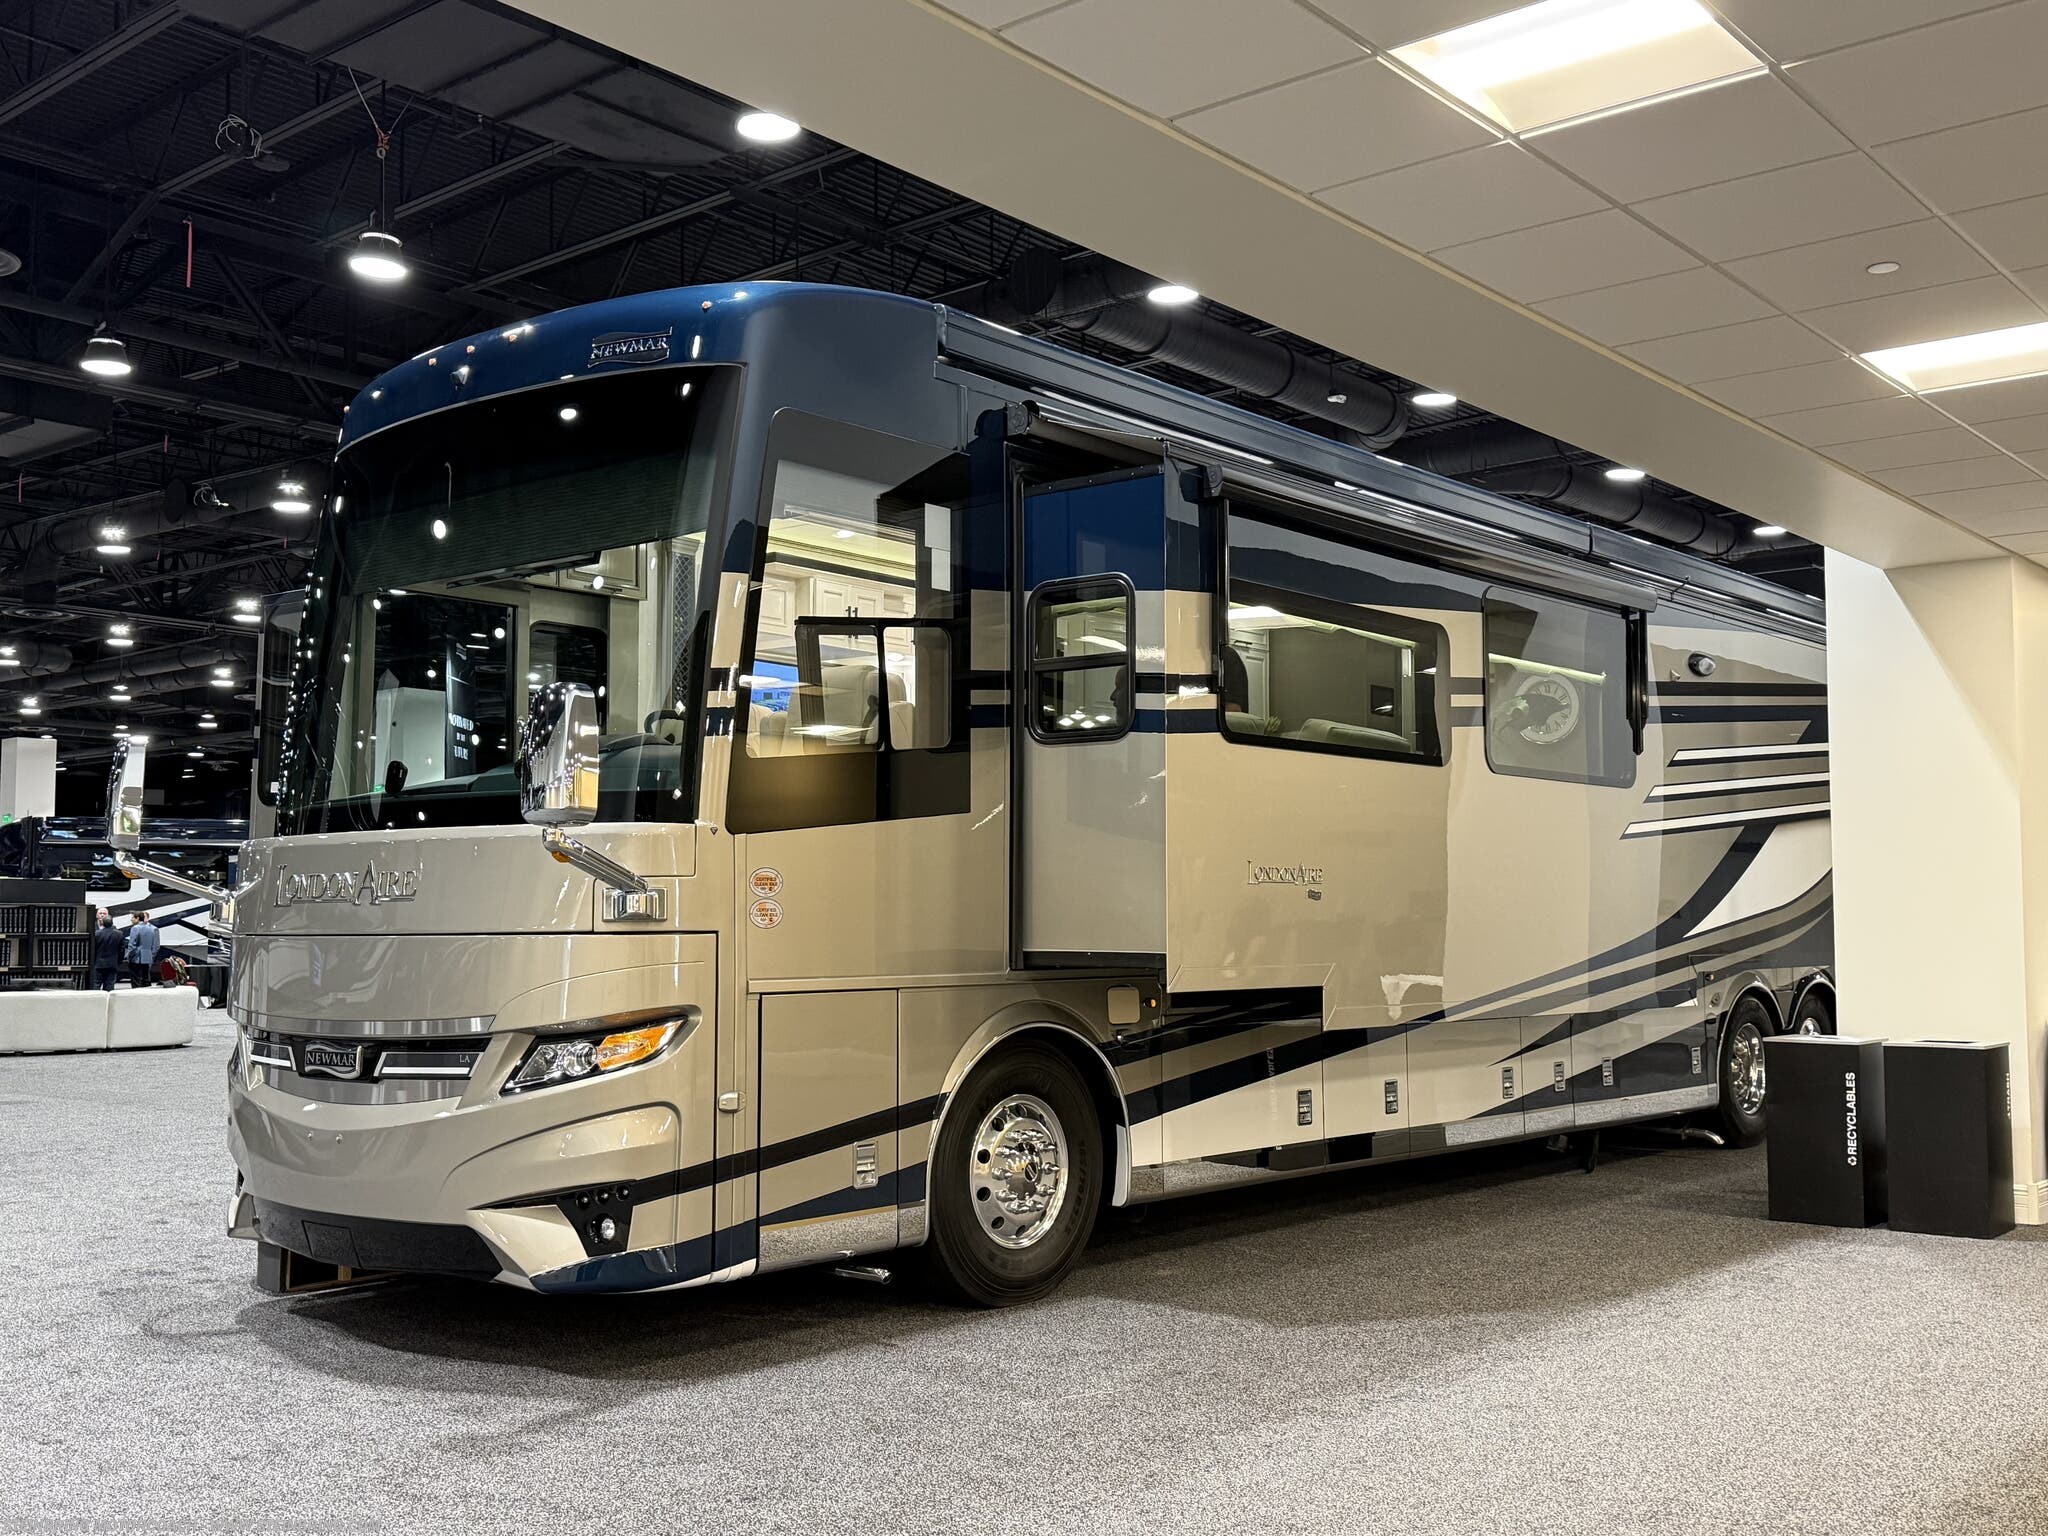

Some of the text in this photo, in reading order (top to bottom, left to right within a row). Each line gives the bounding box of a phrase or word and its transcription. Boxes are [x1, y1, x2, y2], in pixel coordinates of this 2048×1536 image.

[590, 337, 669, 360] NEWMAR
[306, 1051, 356, 1067] NEWMAR
[459, 1054, 471, 1064] LA
[1845, 1072, 1857, 1155] RECYCLABLES
